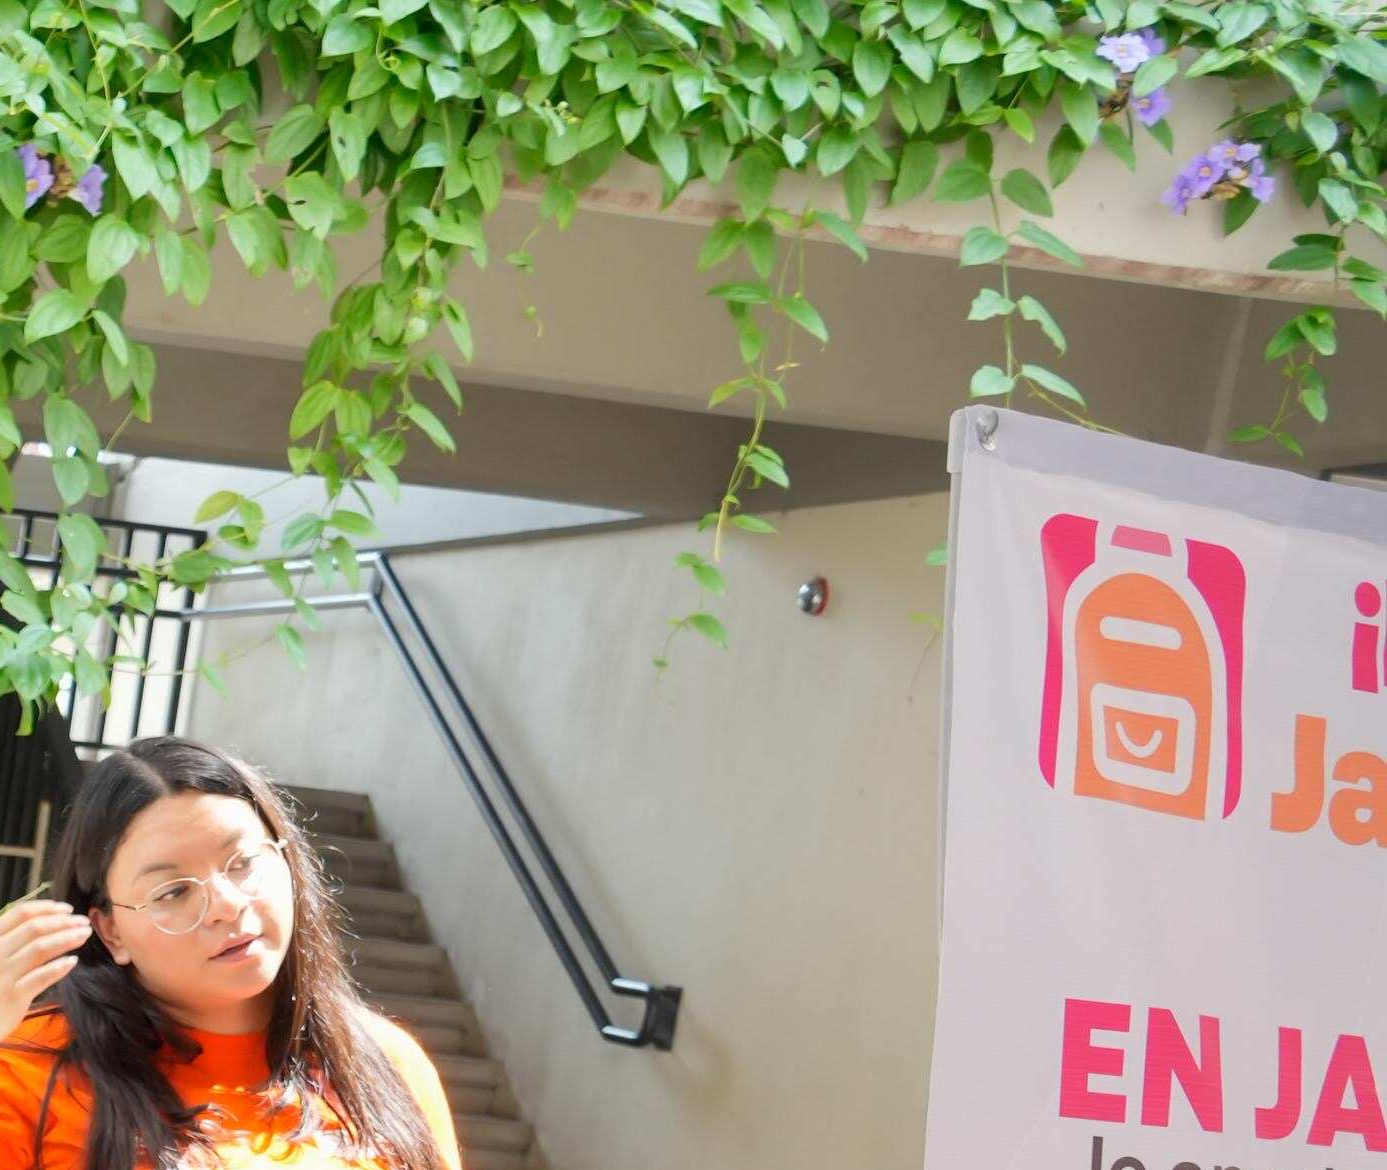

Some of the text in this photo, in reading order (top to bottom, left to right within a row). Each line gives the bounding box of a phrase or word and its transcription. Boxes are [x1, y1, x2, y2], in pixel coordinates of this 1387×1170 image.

[1270, 713, 1387, 849] Ja
[1059, 998, 1387, 1152] EN JA
